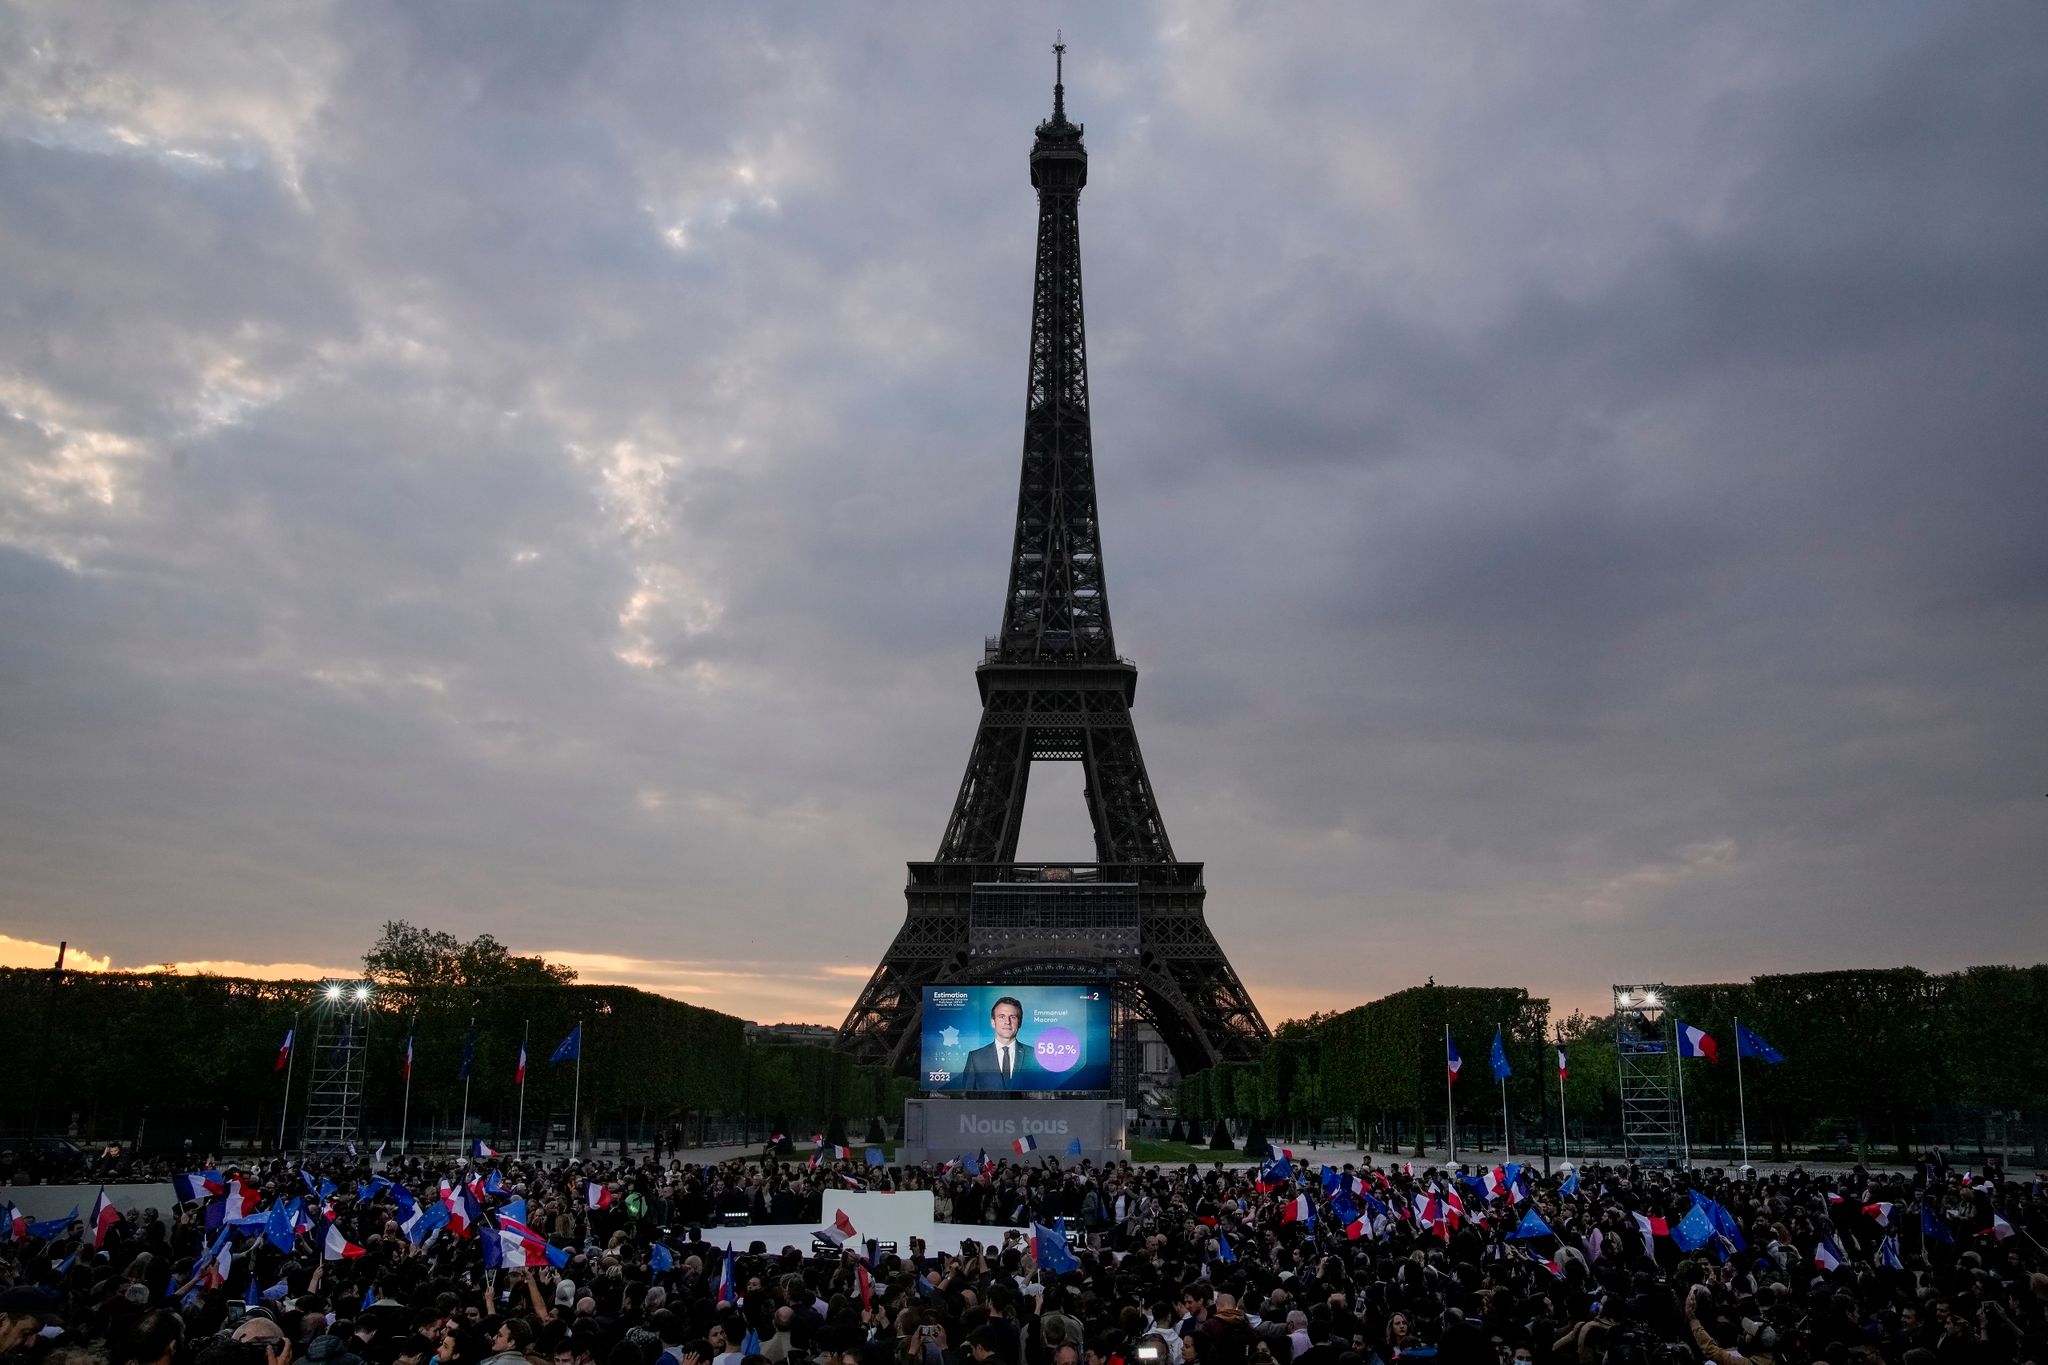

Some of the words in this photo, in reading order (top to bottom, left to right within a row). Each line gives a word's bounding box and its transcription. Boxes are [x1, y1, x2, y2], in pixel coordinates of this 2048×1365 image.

[1037, 1042, 1077, 1056] 58,2%
[959, 1113, 1016, 1134] Nous
[1021, 1115, 1069, 1135] tous
